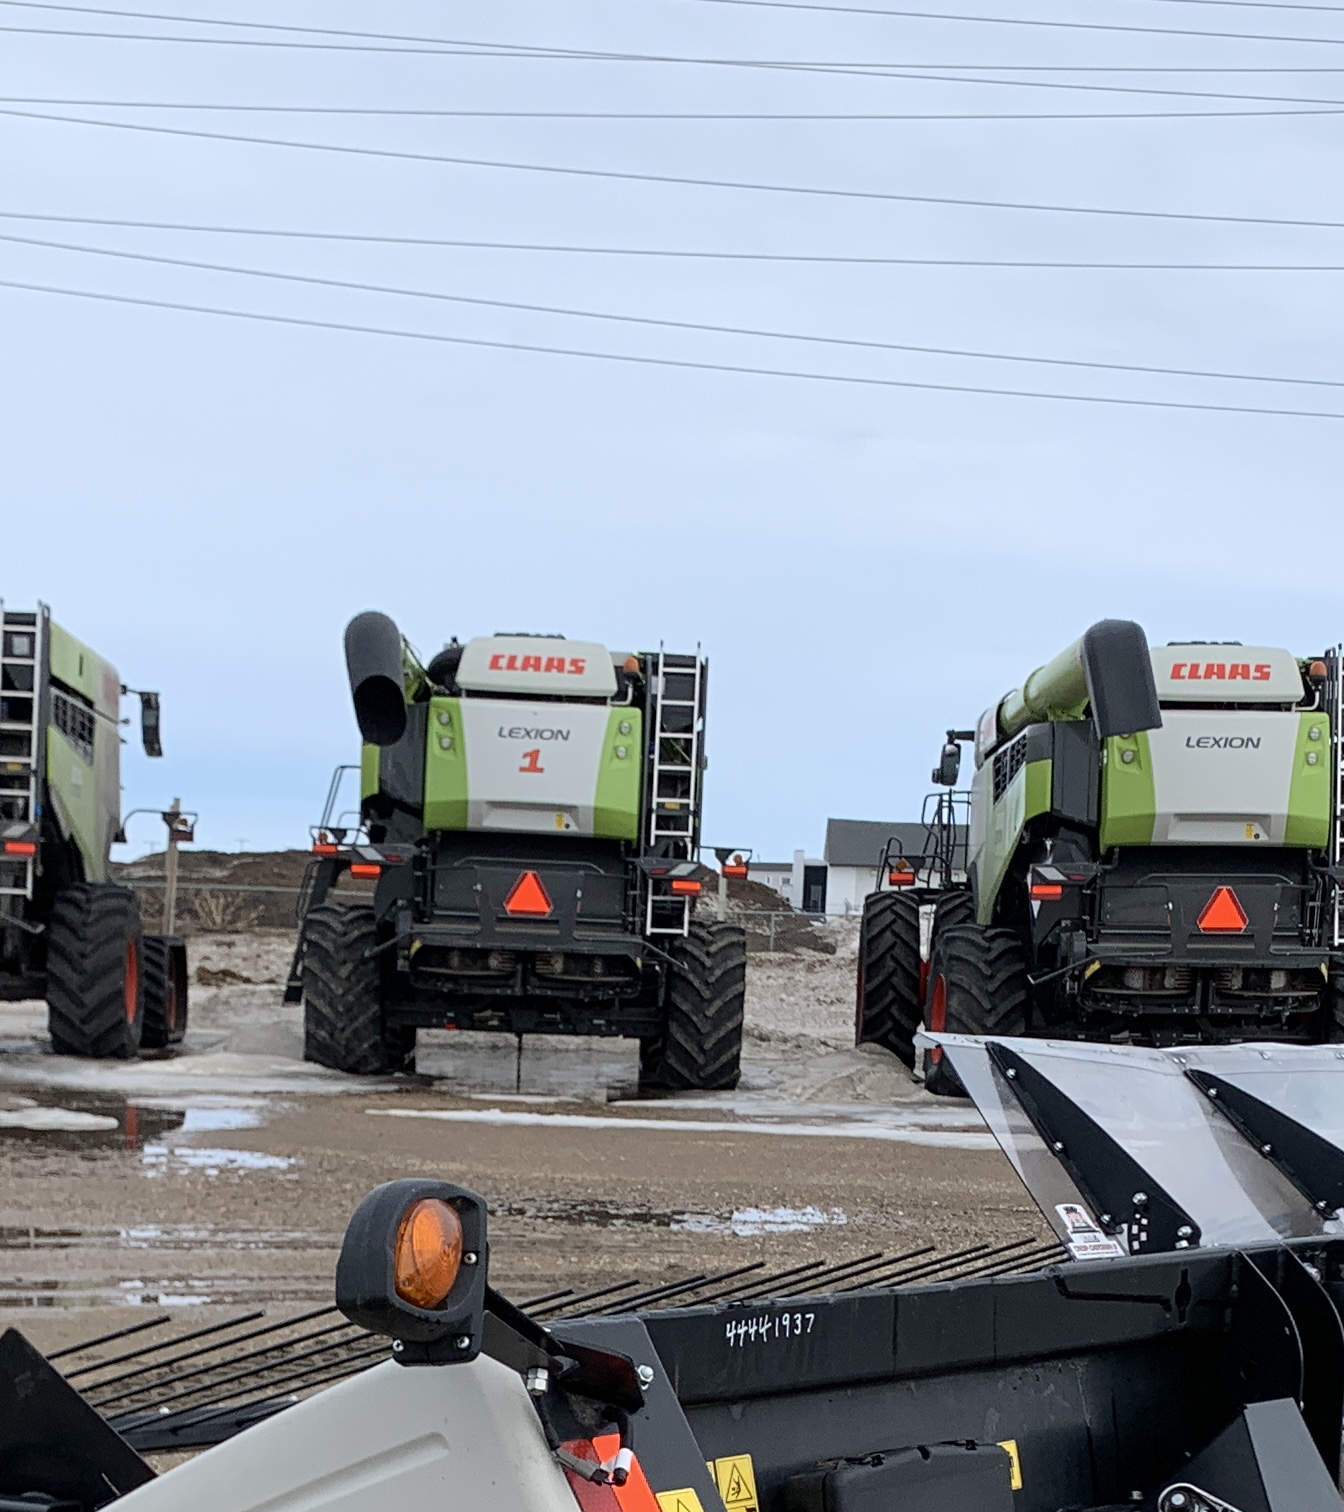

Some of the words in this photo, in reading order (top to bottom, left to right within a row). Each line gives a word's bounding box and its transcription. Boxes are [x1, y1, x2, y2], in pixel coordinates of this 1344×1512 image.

[488, 654, 586, 675] CLAAS
[1170, 663, 1272, 681] CLAAS
[497, 726, 570, 741] LEXION
[1185, 736, 1261, 749] LEXION
[518, 748, 545, 773] 1
[726, 1313, 815, 1347] 44441937
